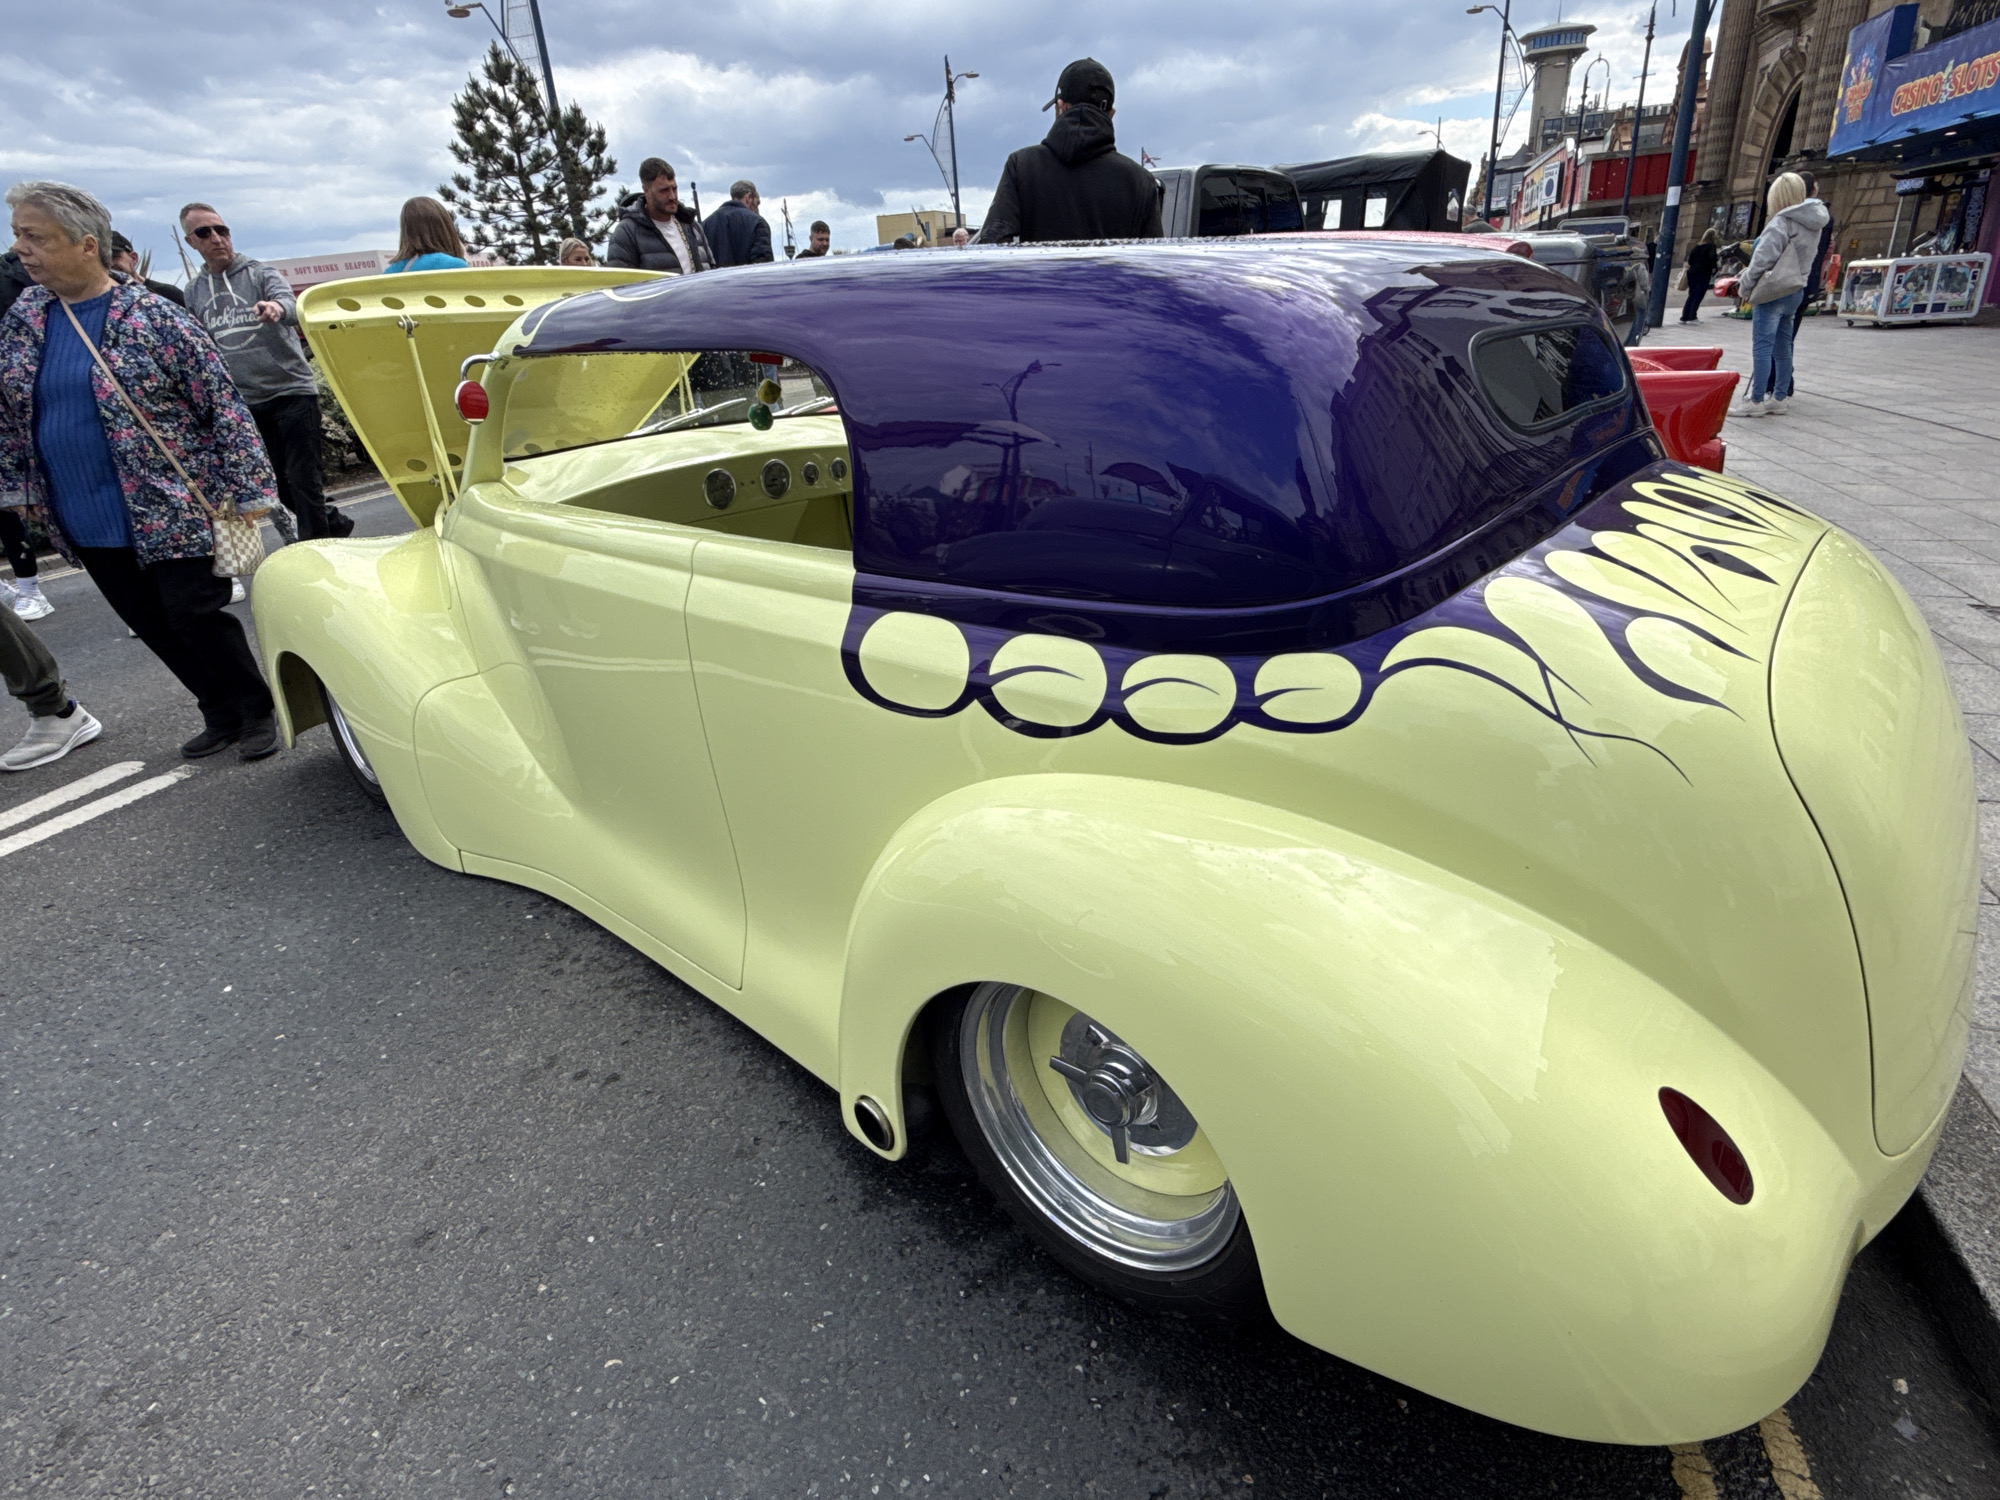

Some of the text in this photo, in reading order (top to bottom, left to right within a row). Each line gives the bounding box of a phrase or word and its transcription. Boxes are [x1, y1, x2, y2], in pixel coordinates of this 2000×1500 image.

[1891, 50, 2000, 117] CASINO SLOTS
[294, 266, 312, 275] SOFT
[313, 263, 339, 274] DRINKS
[344, 260, 376, 271] SEAFOOD
